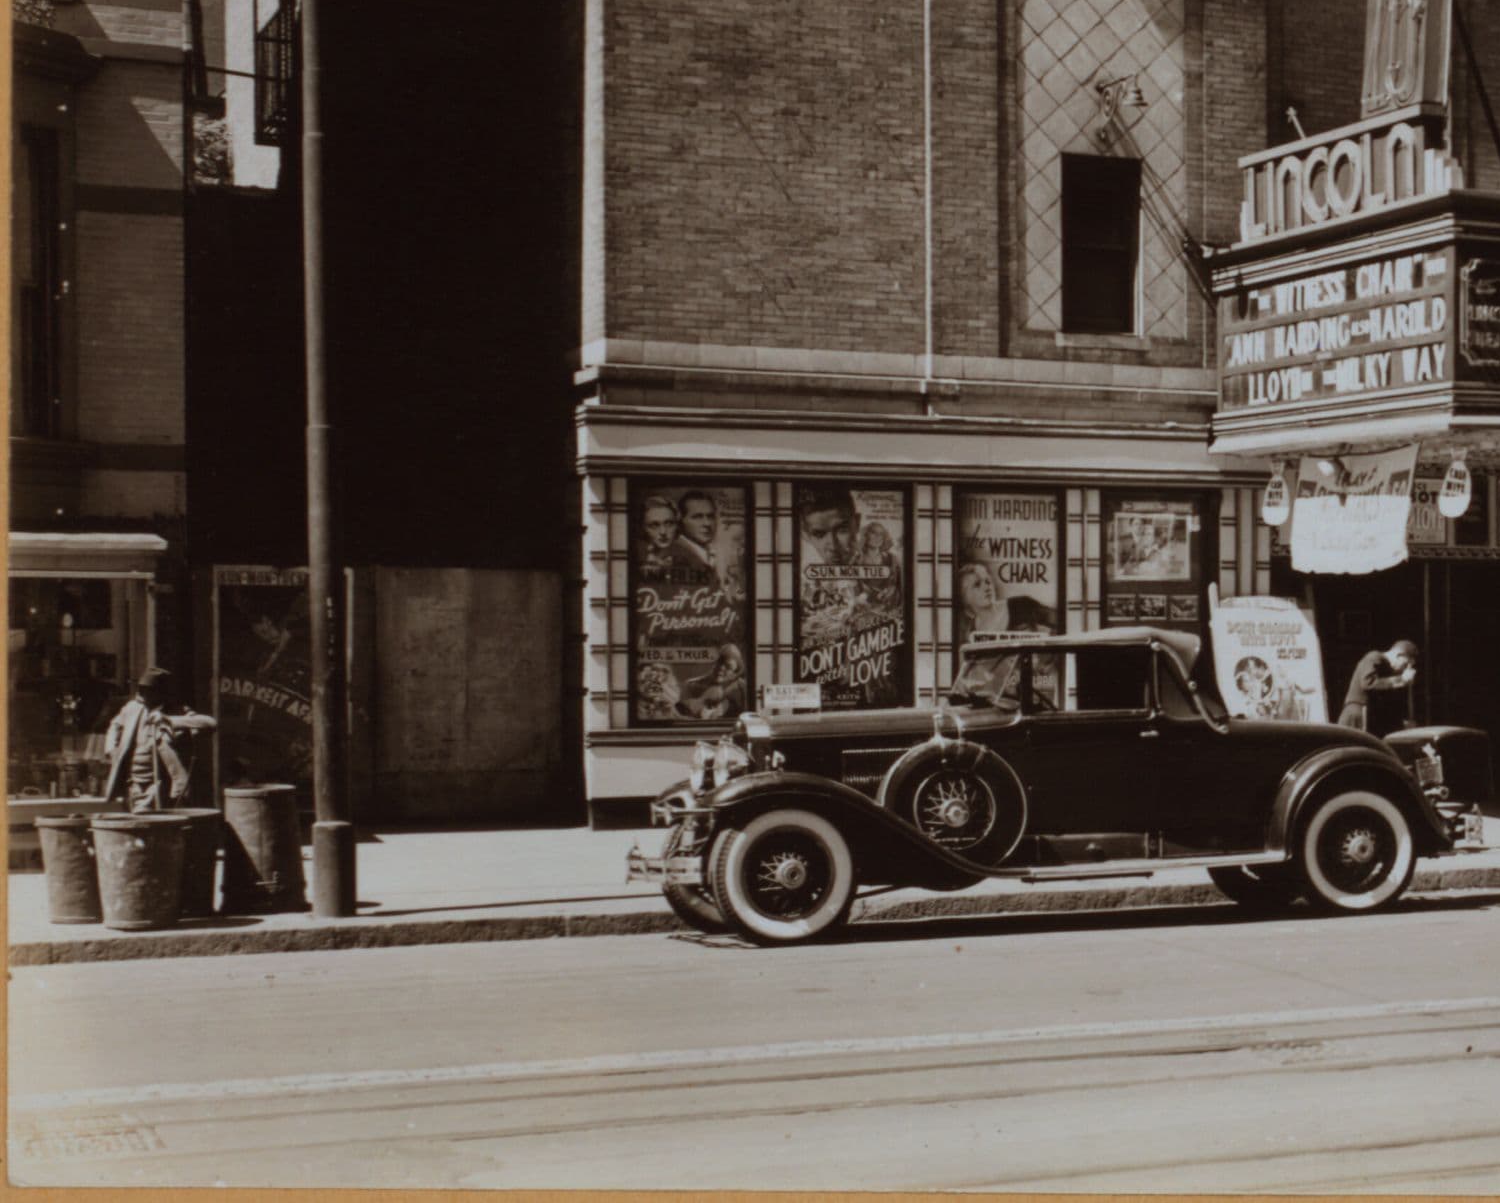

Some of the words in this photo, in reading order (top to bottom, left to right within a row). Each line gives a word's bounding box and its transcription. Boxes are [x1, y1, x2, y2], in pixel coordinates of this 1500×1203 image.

[1243, 123, 1415, 242] LINCOLN
[1275, 271, 1346, 314] WITNESS
[1275, 314, 1350, 357] HARDING
[1369, 298, 1447, 342] HAROLD
[1248, 367, 1302, 406] LLOYD
[1336, 352, 1391, 391] MILKY
[1403, 344, 1446, 382] WAY
[993, 499, 1058, 522] HARDING
[988, 537, 1053, 559] WITNESS
[810, 565, 836, 578] SUN
[839, 565, 860, 578] MON
[864, 565, 885, 578] TUE
[997, 561, 1049, 584] CHAIR
[690, 587, 726, 614] Get
[842, 619, 905, 662] GAMBLE
[848, 651, 891, 687] LOVE
[220, 676, 290, 709] DARKEST
